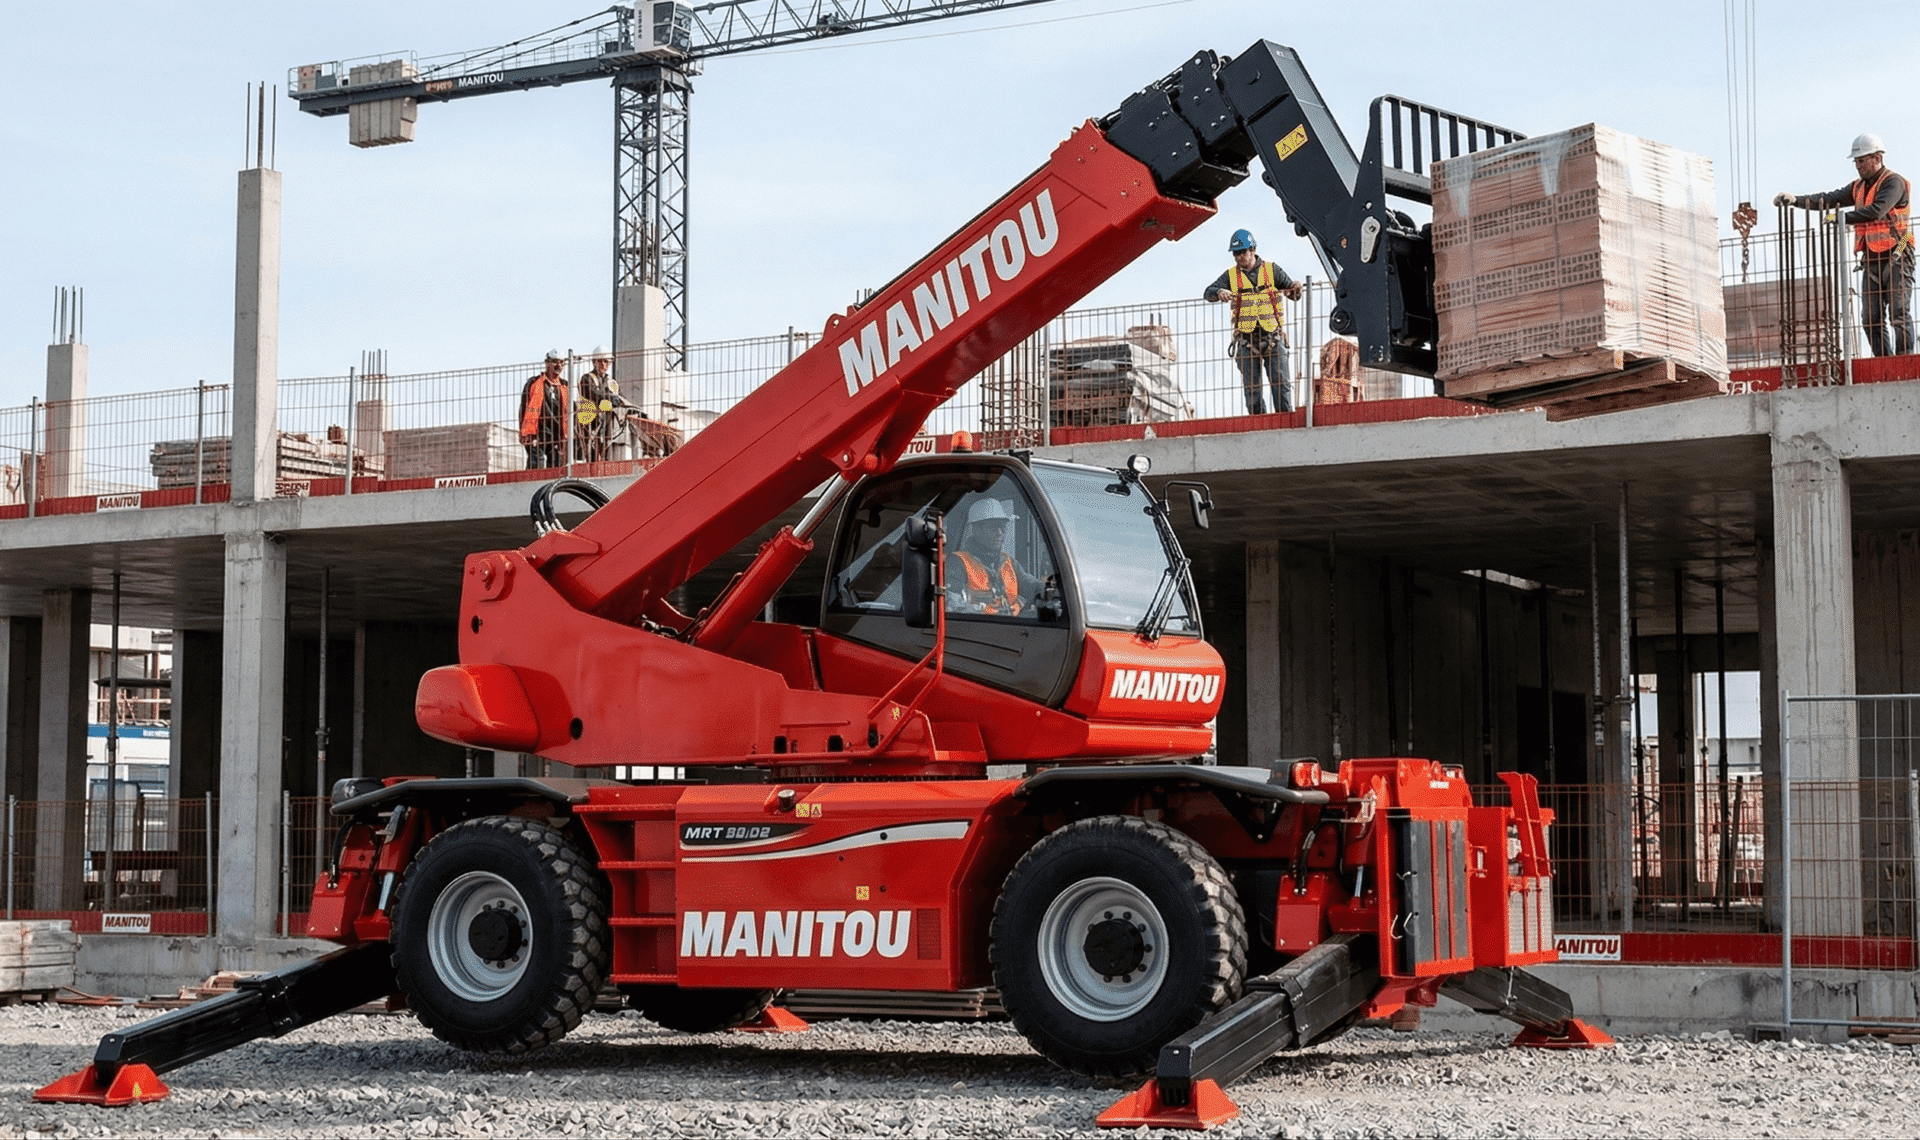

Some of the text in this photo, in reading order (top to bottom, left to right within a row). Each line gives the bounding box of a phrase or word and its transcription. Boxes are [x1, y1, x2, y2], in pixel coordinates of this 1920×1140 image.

[458, 72, 504, 88] MANITOU
[837, 187, 1059, 398] MANITOU
[98, 495, 139, 509] MANITOU
[1109, 668, 1221, 704] MANITOU
[684, 827, 724, 839] MRT
[104, 916, 150, 928] MANITOU
[680, 910, 912, 958] MANITOU
[1556, 938, 1619, 954] ANITOU
